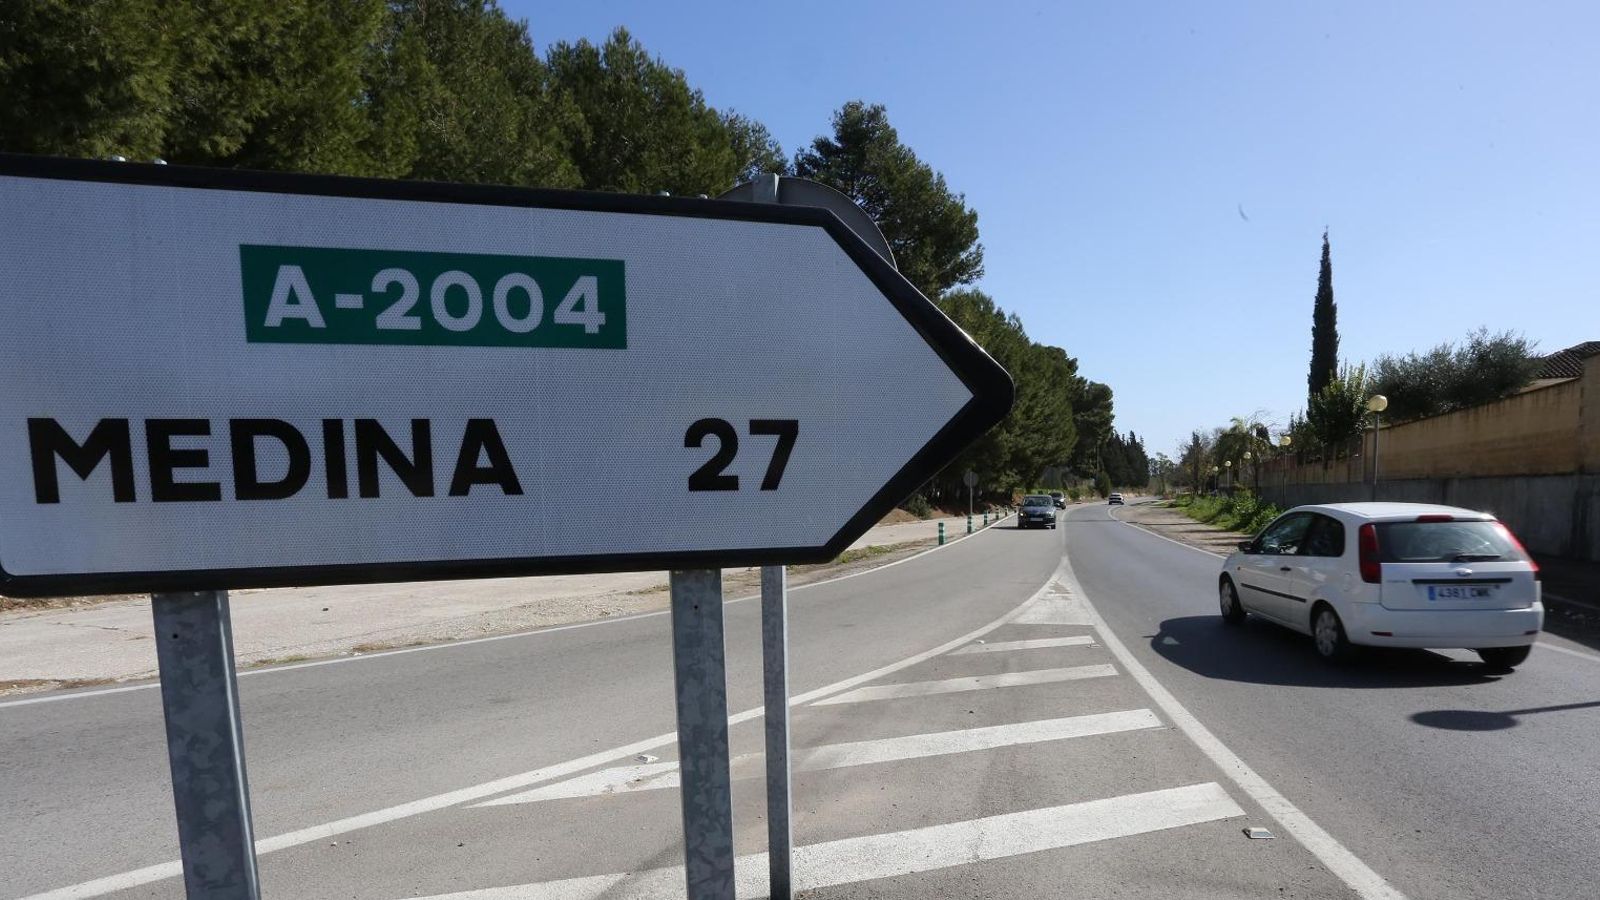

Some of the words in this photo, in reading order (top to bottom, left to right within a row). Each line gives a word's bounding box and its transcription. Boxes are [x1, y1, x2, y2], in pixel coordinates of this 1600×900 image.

[263, 264, 606, 335] A-2004
[27, 417, 525, 504] MEDINA
[684, 417, 799, 491] 27
